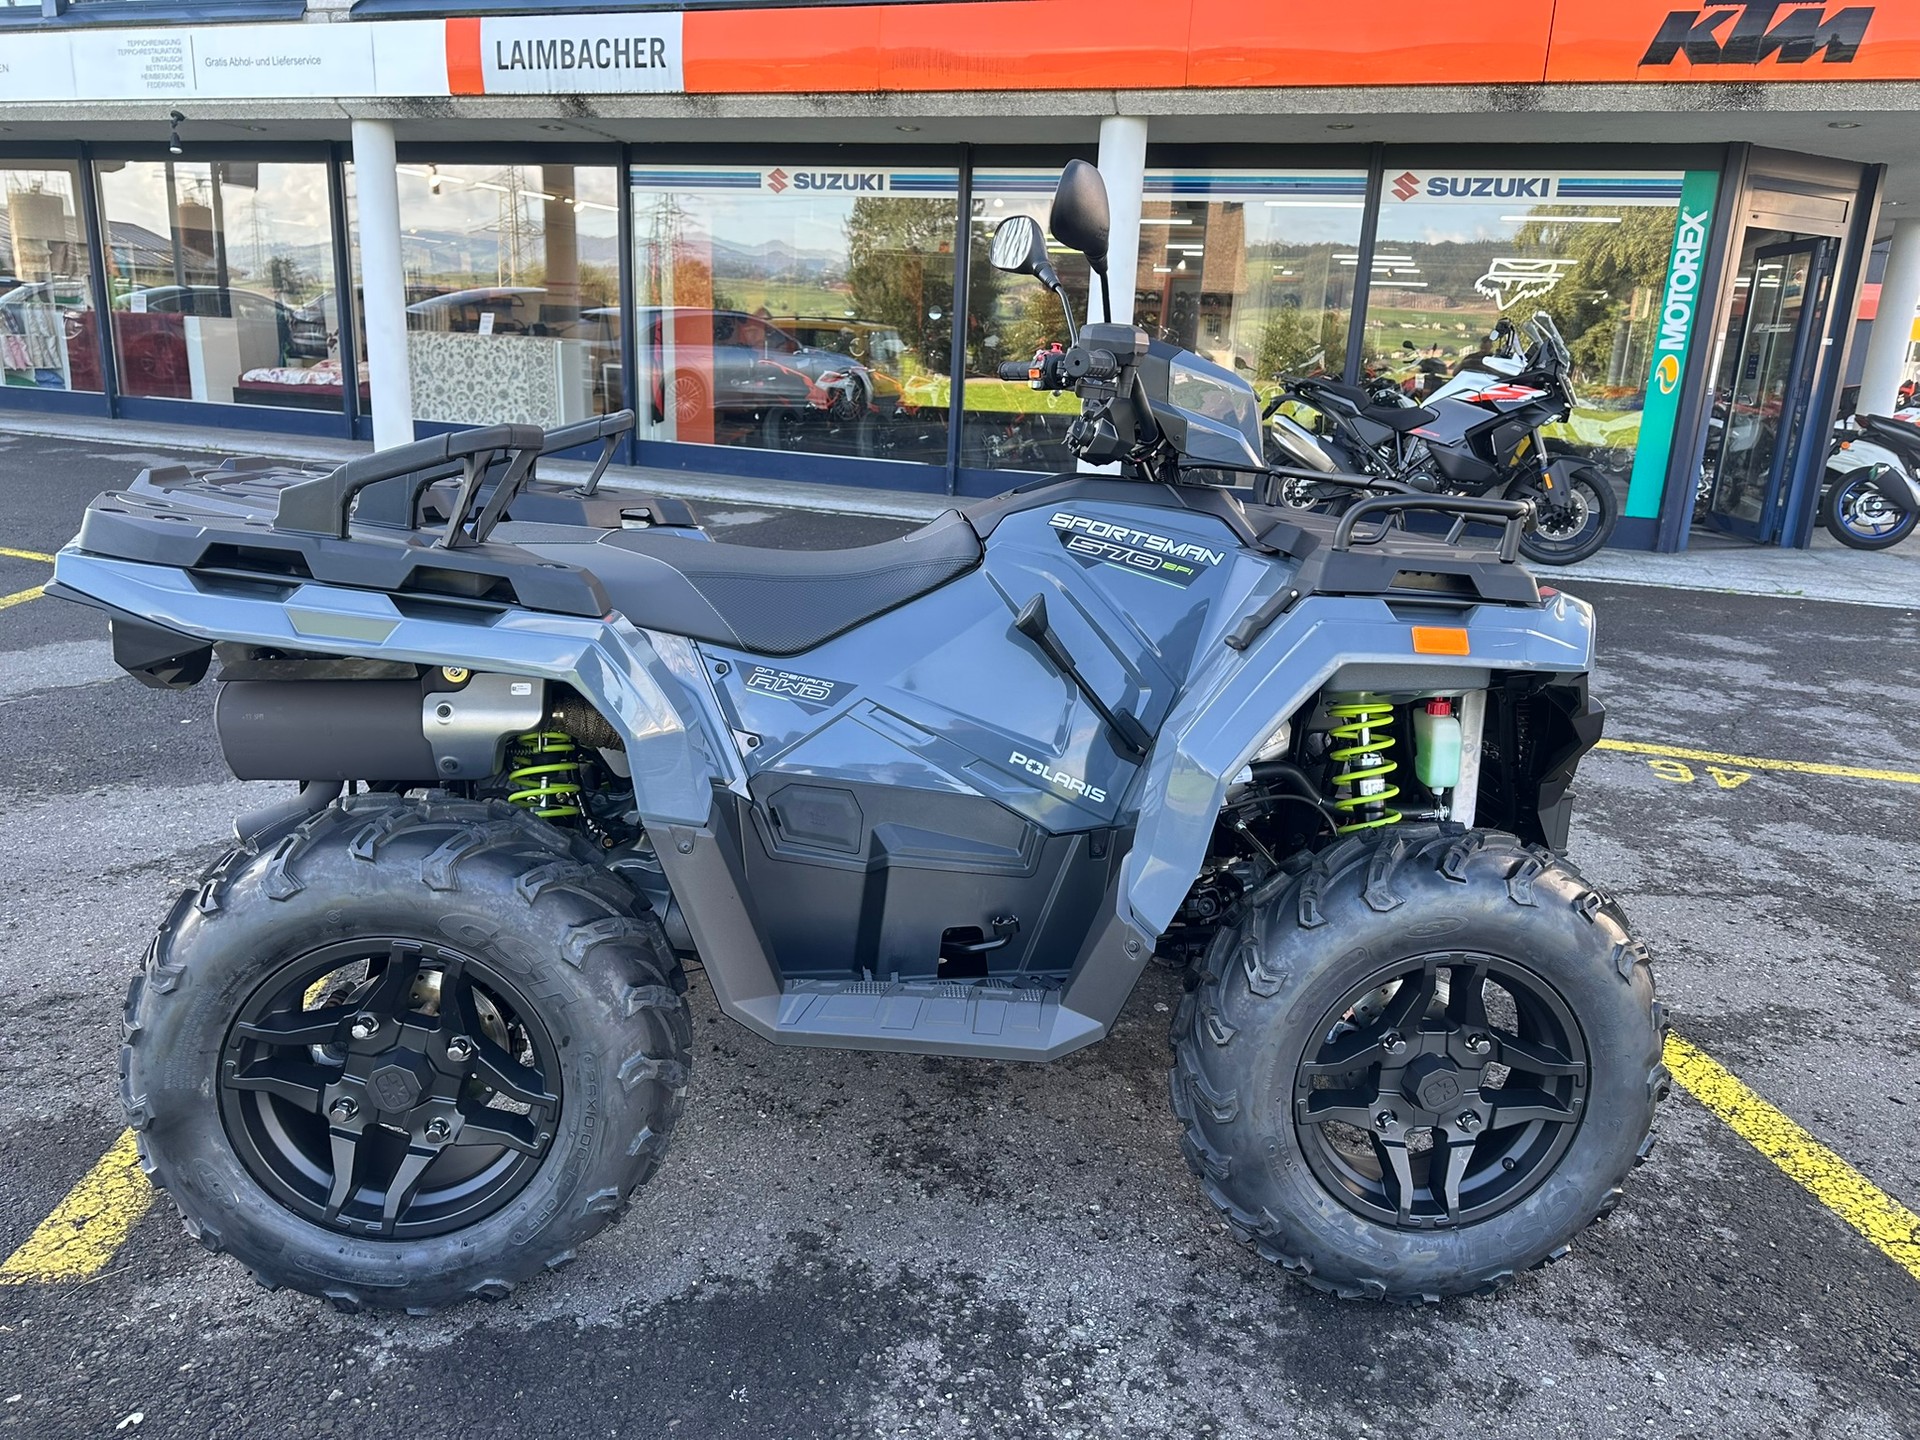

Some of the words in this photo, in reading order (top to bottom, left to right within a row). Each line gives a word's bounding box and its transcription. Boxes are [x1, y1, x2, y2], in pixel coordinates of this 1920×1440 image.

[1638, 0, 1876, 66] KTM
[205, 57, 228, 67] Gratis
[229, 57, 254, 67] Abhol-
[255, 57, 271, 66] und
[272, 55, 322, 66] Lieferservice
[496, 37, 667, 70] LAIMBACHER
[793, 172, 884, 191] SUZUKI
[1426, 177, 1551, 198] SUZUKI
[1658, 210, 1709, 351] MOTOREX
[1048, 511, 1227, 567] SPORTSMAN
[1067, 535, 1163, 571] 570
[1161, 561, 1194, 576] EFI
[747, 672, 831, 701] AWD
[755, 666, 775, 675] ON
[779, 671, 834, 688] DEMAND
[1008, 750, 1107, 803] POLARIS
